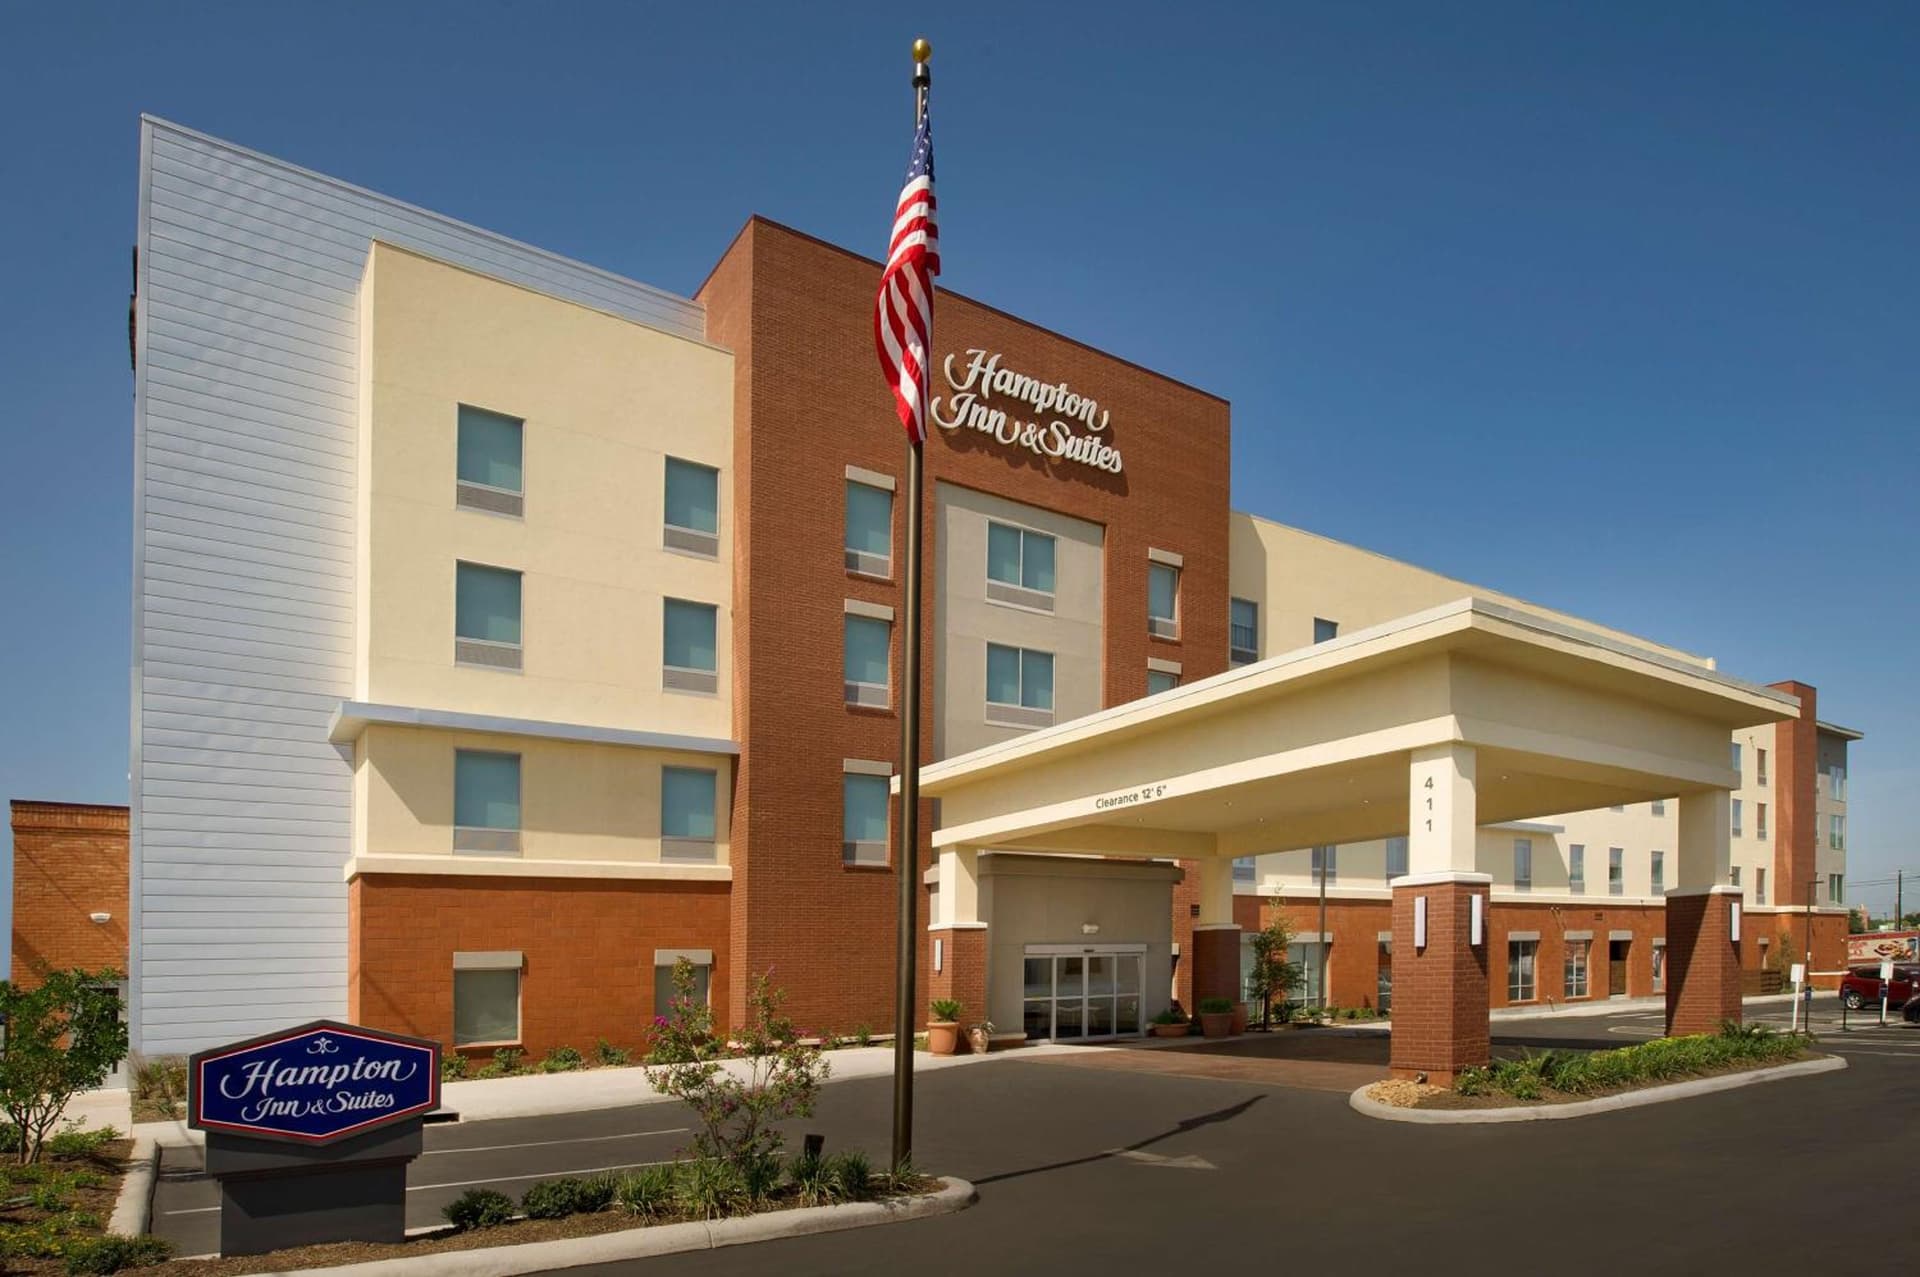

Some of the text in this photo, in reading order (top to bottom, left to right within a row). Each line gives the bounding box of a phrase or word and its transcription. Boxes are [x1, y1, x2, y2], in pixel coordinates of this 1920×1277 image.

[944, 349, 1109, 431] Hampton
[930, 393, 1123, 473] Inn & Suites
[1095, 792, 1139, 809] Clearance
[219, 1056, 417, 1099] Hampton
[240, 1090, 395, 1121] Inn & Suites
